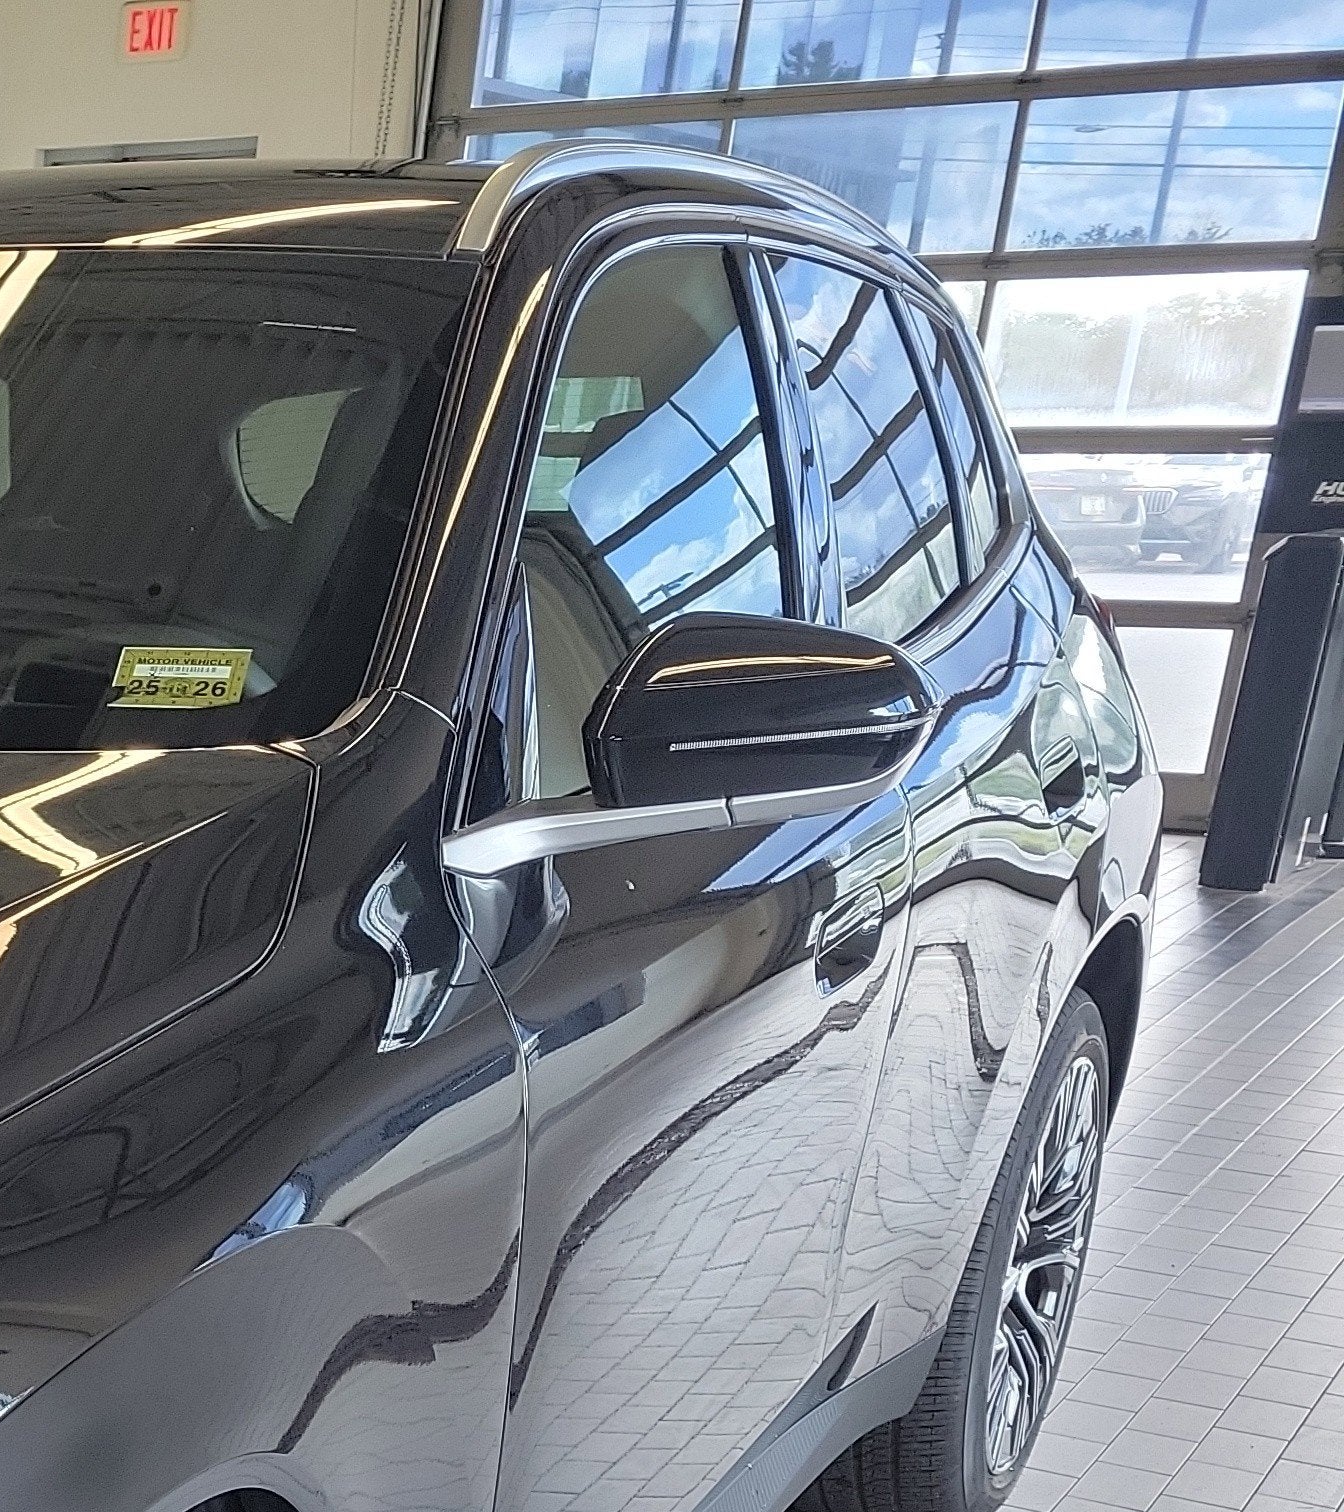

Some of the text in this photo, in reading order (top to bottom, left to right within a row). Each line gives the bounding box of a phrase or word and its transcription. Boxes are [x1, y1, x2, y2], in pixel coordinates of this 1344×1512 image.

[129, 7, 179, 53] EXIT
[136, 657, 233, 666] MOTOR VEHICLE
[127, 679, 161, 696] 25
[193, 680, 228, 697] 26
